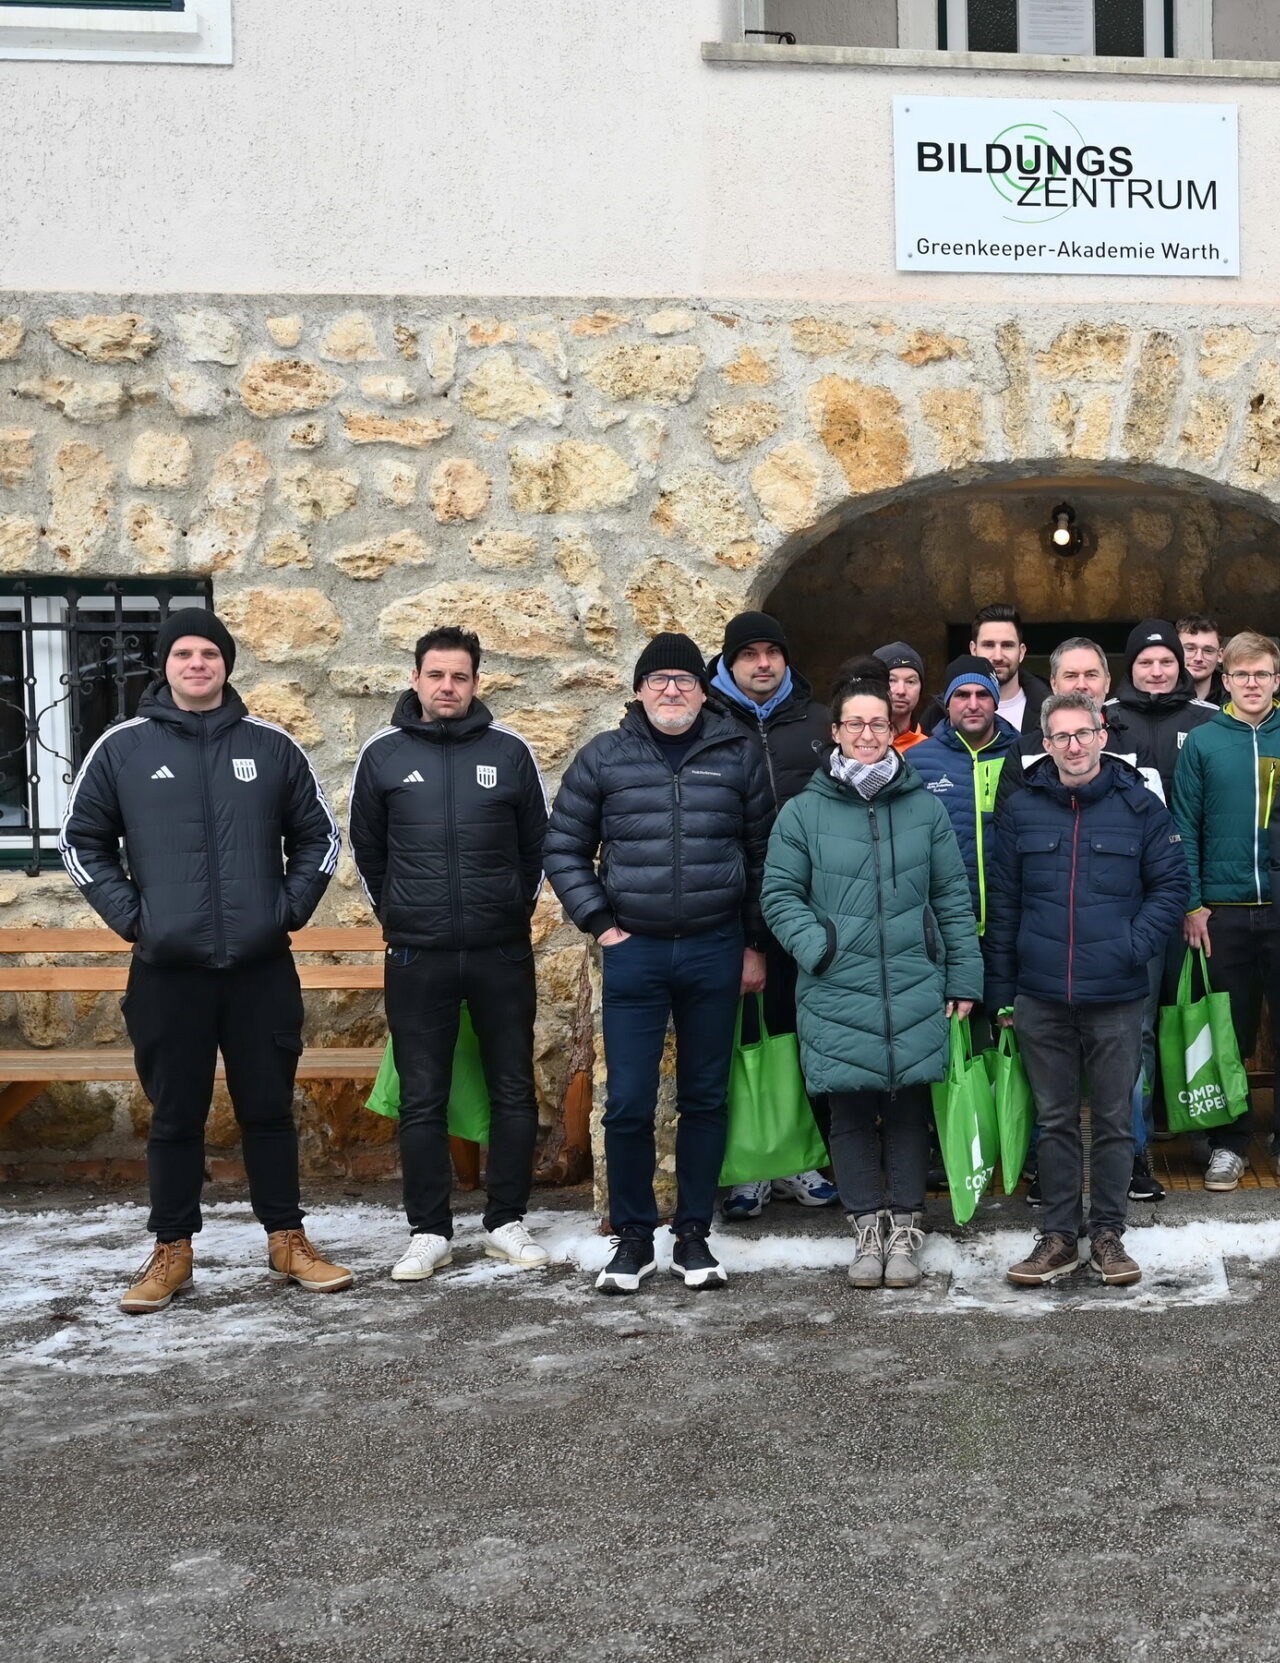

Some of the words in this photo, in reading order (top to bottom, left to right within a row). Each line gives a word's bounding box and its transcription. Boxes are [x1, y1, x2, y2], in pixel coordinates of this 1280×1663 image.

[916, 141, 1134, 177] BILDUNGS
[1016, 176, 1218, 210] ZENTRUM
[916, 238, 1156, 260] Greenkeeper-Akademie
[1161, 242, 1220, 260] Warth
